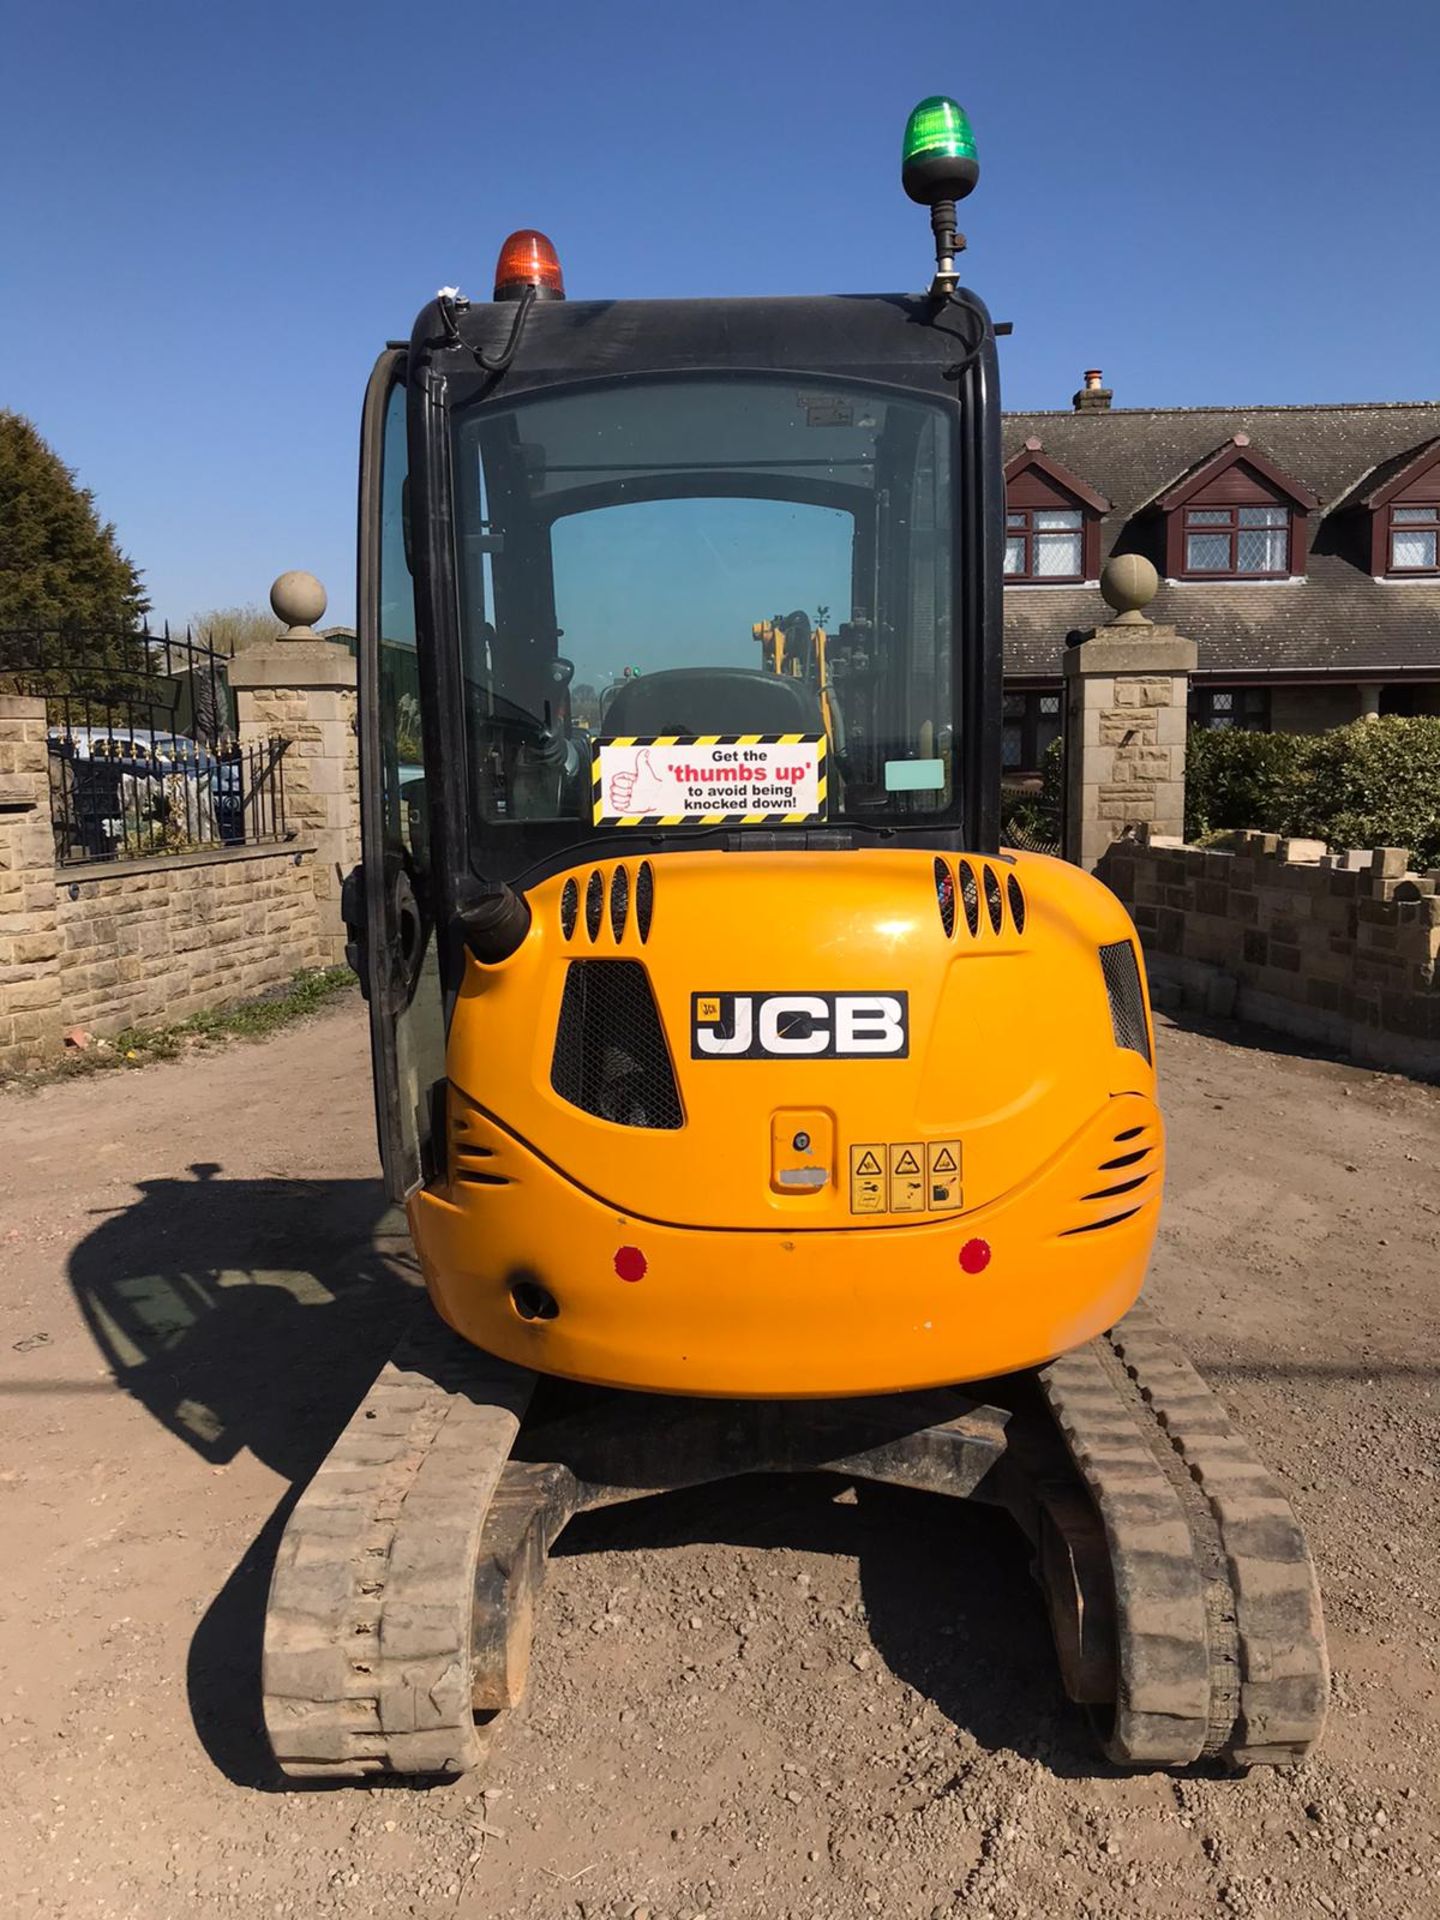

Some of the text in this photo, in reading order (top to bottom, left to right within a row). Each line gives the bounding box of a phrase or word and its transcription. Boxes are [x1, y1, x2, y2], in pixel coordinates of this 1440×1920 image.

[712, 750, 768, 762] Get the
[667, 762, 812, 784] 'thumbs up'
[688, 784, 794, 797] to avoid being
[684, 797, 797, 810] knocked down!
[696, 996, 905, 1054] JCB
